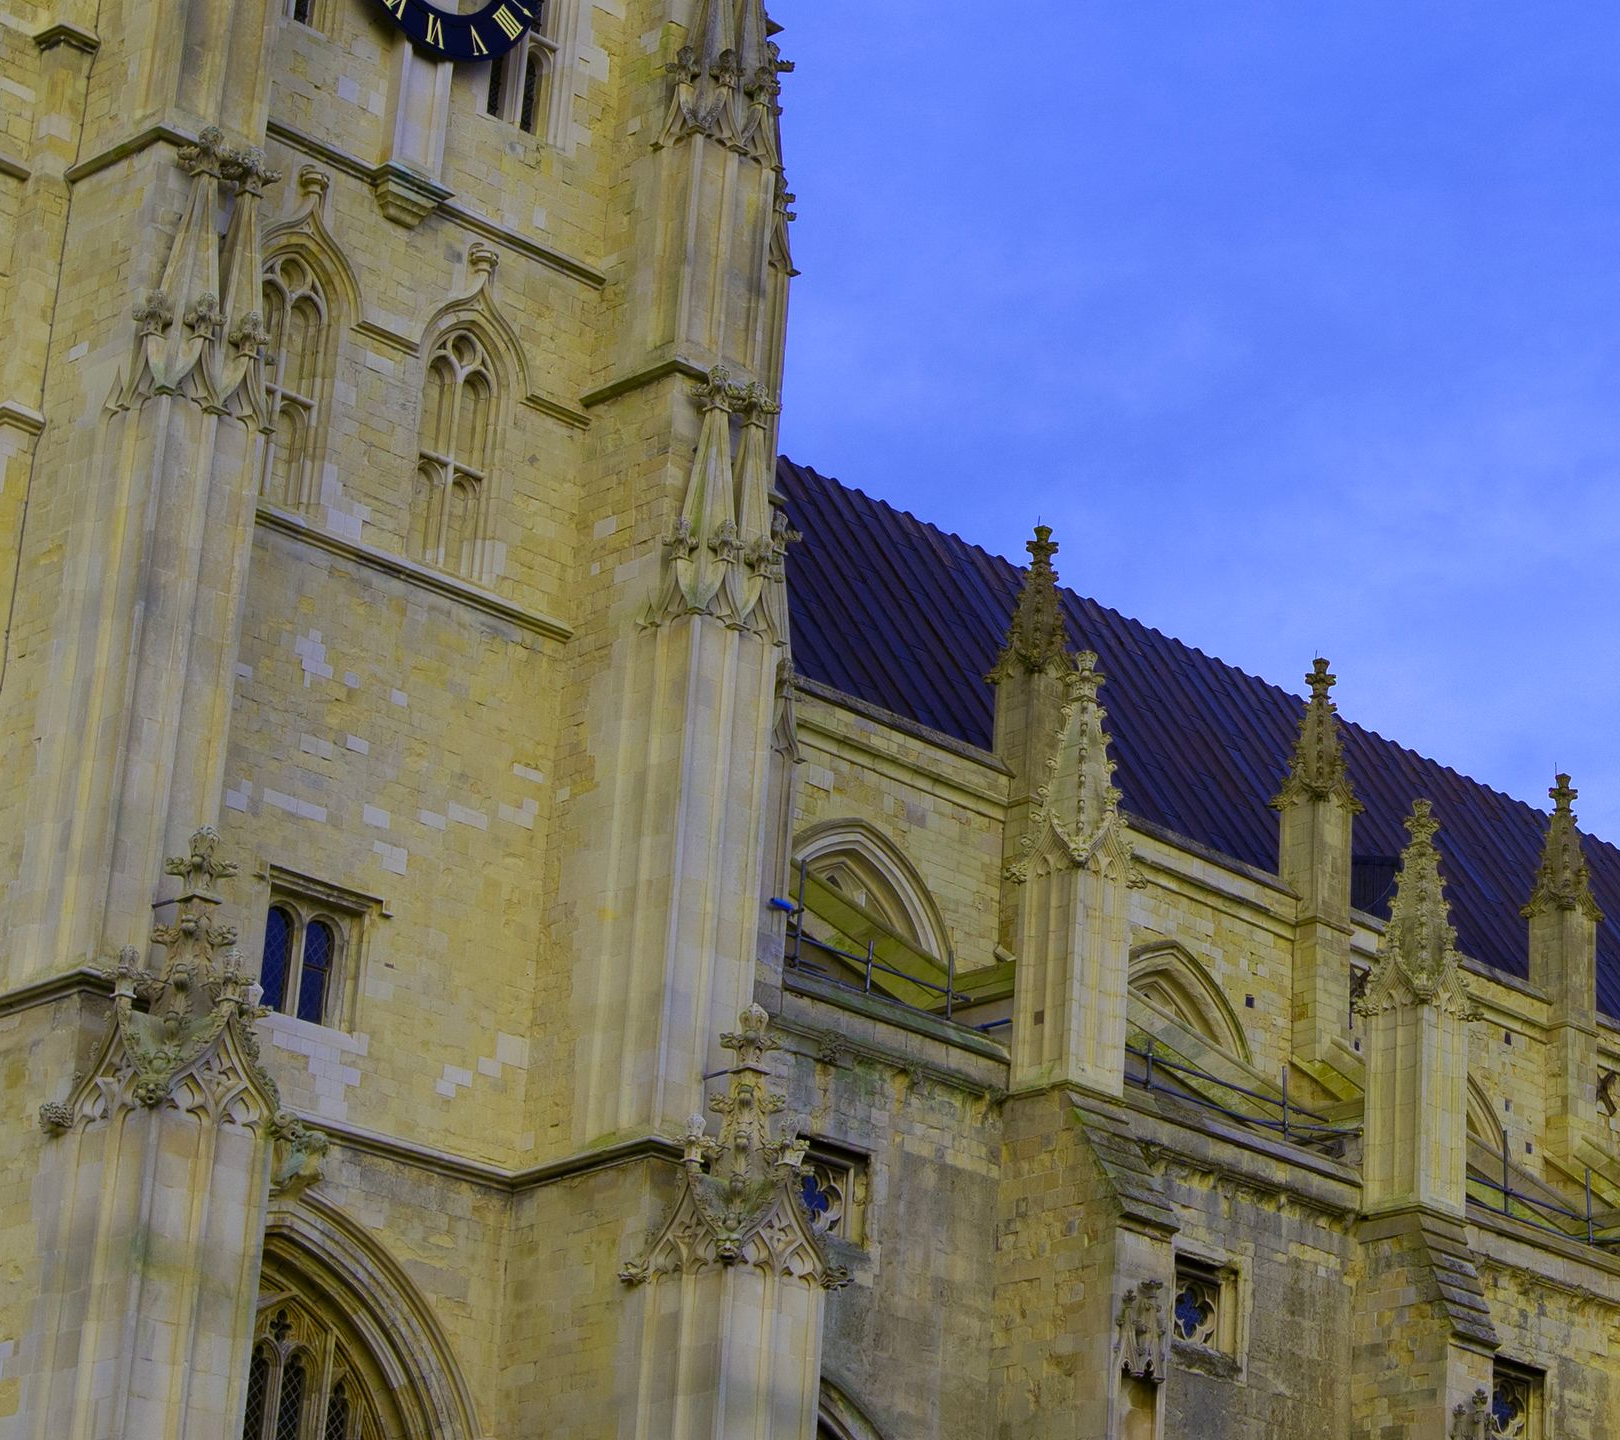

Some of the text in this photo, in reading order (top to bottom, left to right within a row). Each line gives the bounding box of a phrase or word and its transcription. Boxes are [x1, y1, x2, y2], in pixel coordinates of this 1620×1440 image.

[426, 14, 444, 50] VI
[470, 25, 488, 55] V
[493, 4, 523, 41] IIII
